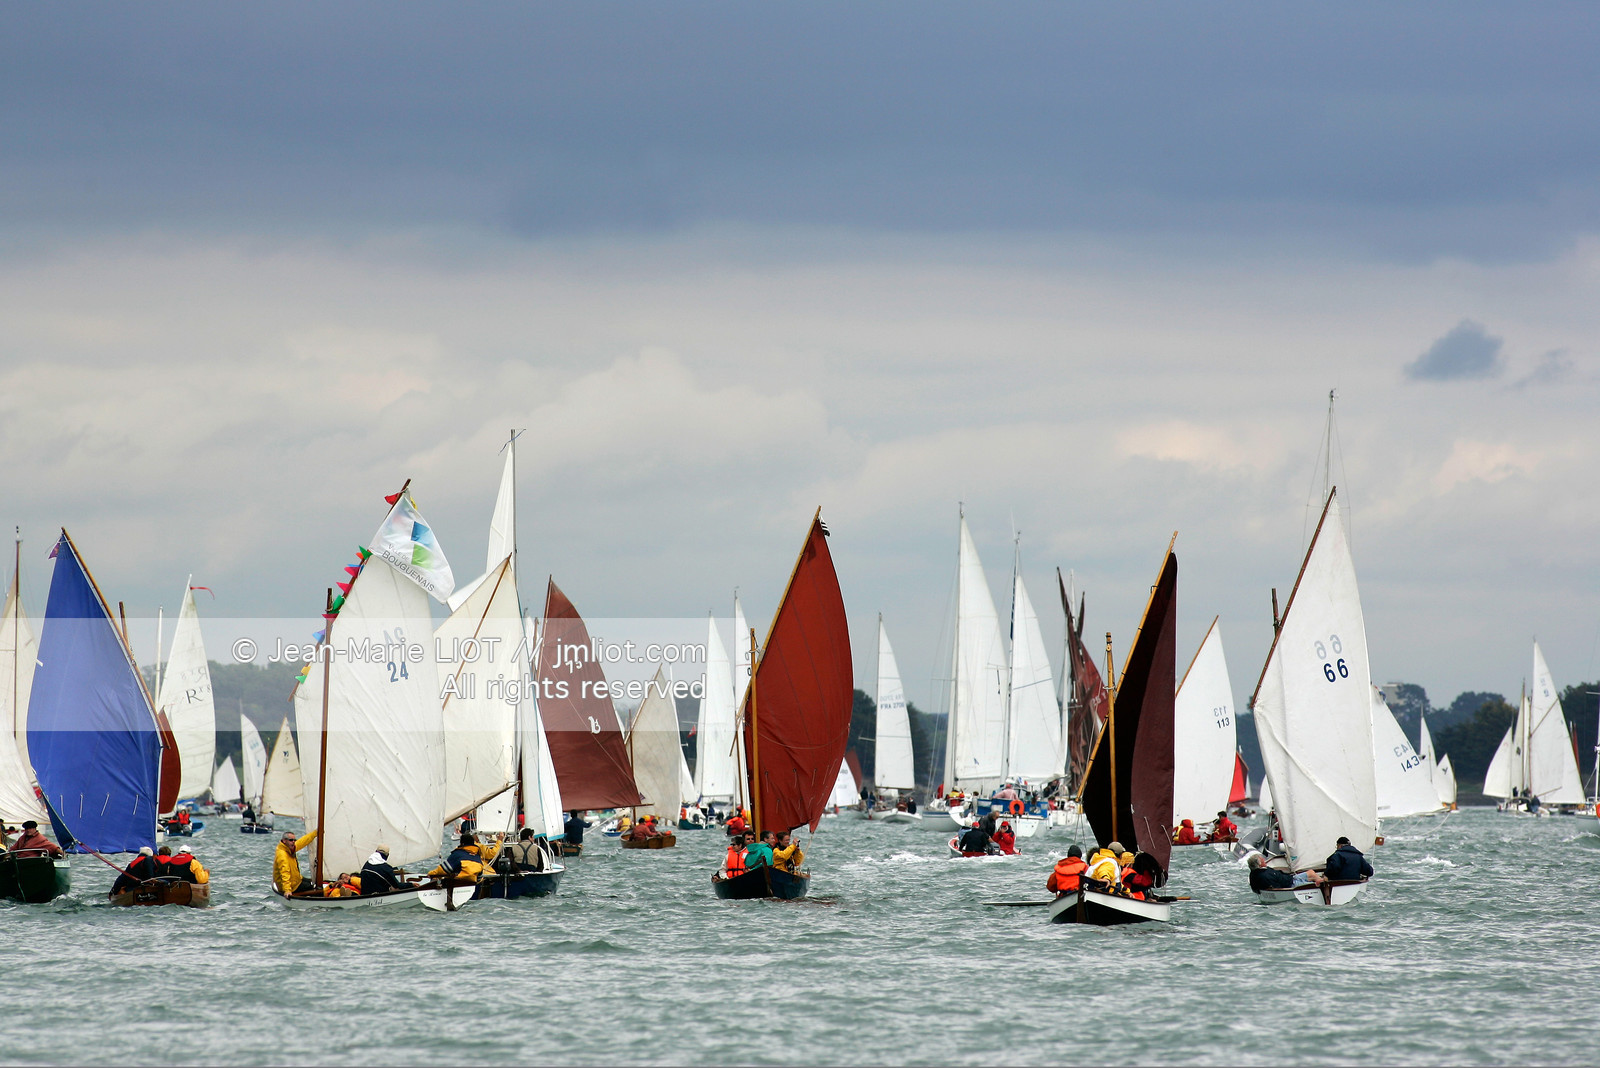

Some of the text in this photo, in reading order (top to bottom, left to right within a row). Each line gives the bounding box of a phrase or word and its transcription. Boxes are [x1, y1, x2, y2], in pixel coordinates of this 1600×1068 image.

[381, 549, 435, 592] BOUGUENAIS
[387, 661, 409, 683] 24
[1323, 658, 1349, 683] 66
[1216, 717, 1230, 728] 113
[1401, 755, 1420, 772] 143
